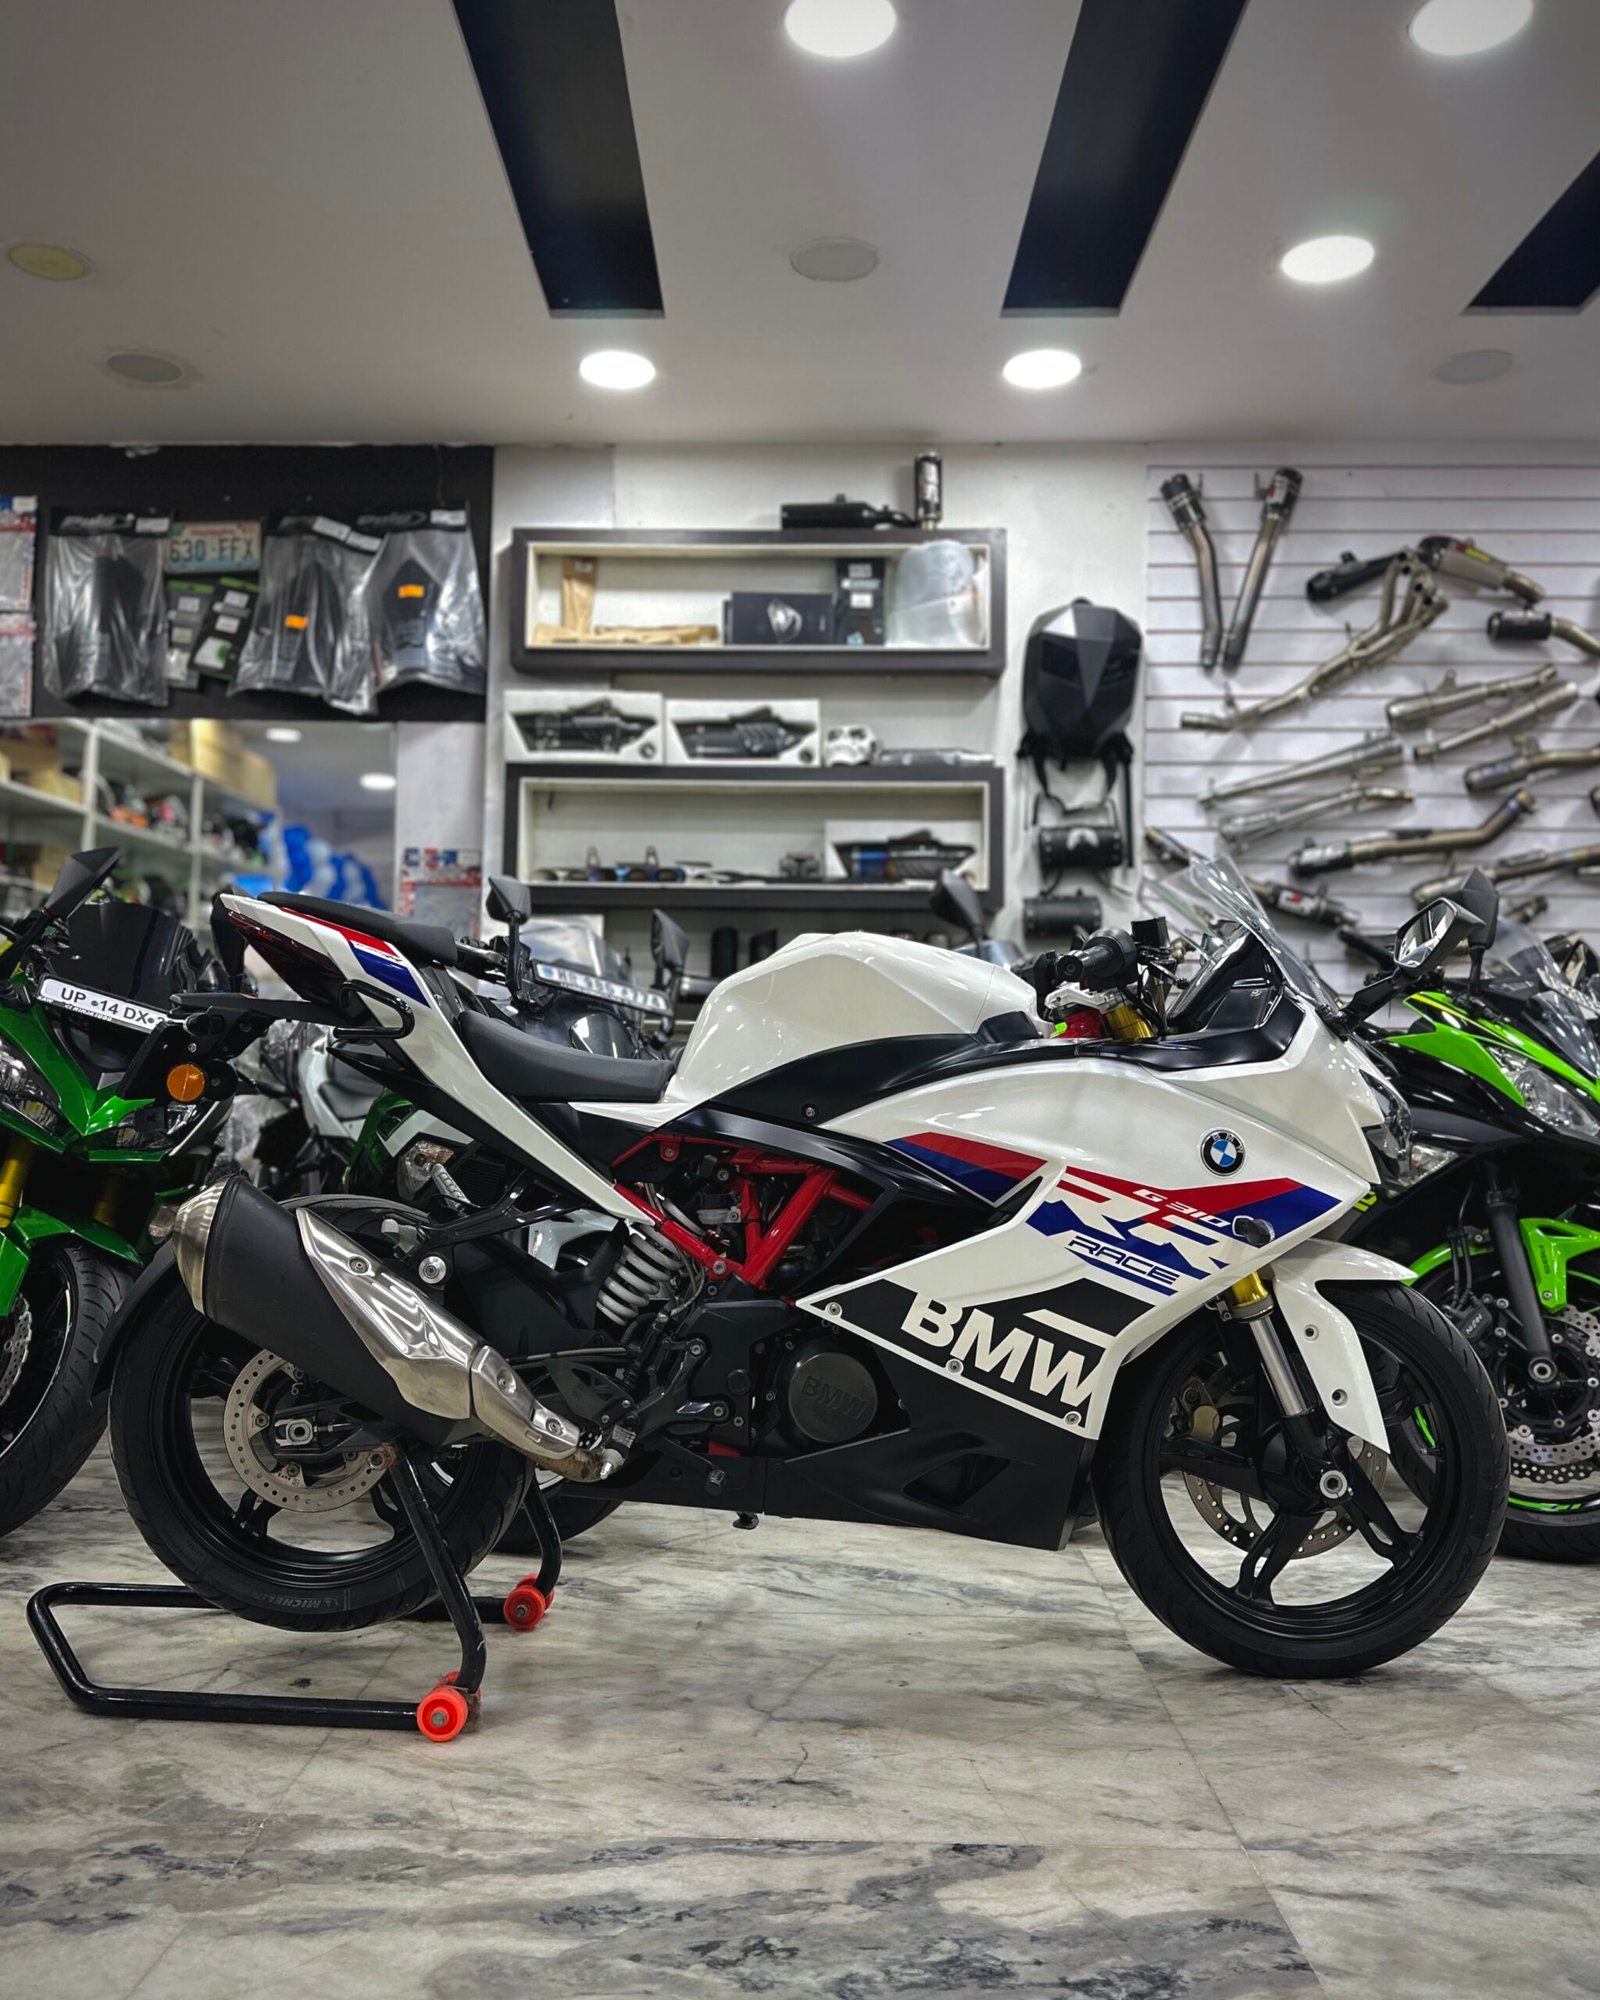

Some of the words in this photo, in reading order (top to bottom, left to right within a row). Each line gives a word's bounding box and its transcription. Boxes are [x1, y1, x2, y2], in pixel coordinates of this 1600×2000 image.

[60, 987, 86, 1003] UP
[100, 1000, 118, 1015] 14
[123, 1006, 149, 1024] DX
[1132, 1188, 1168, 1203] G
[1165, 1201, 1231, 1229] 310
[1067, 1235, 1181, 1286] RACE
[900, 1292, 1102, 1408] BMW
[802, 1375, 870, 1420] BMW
[250, 1588, 322, 1609] MICHELIN
